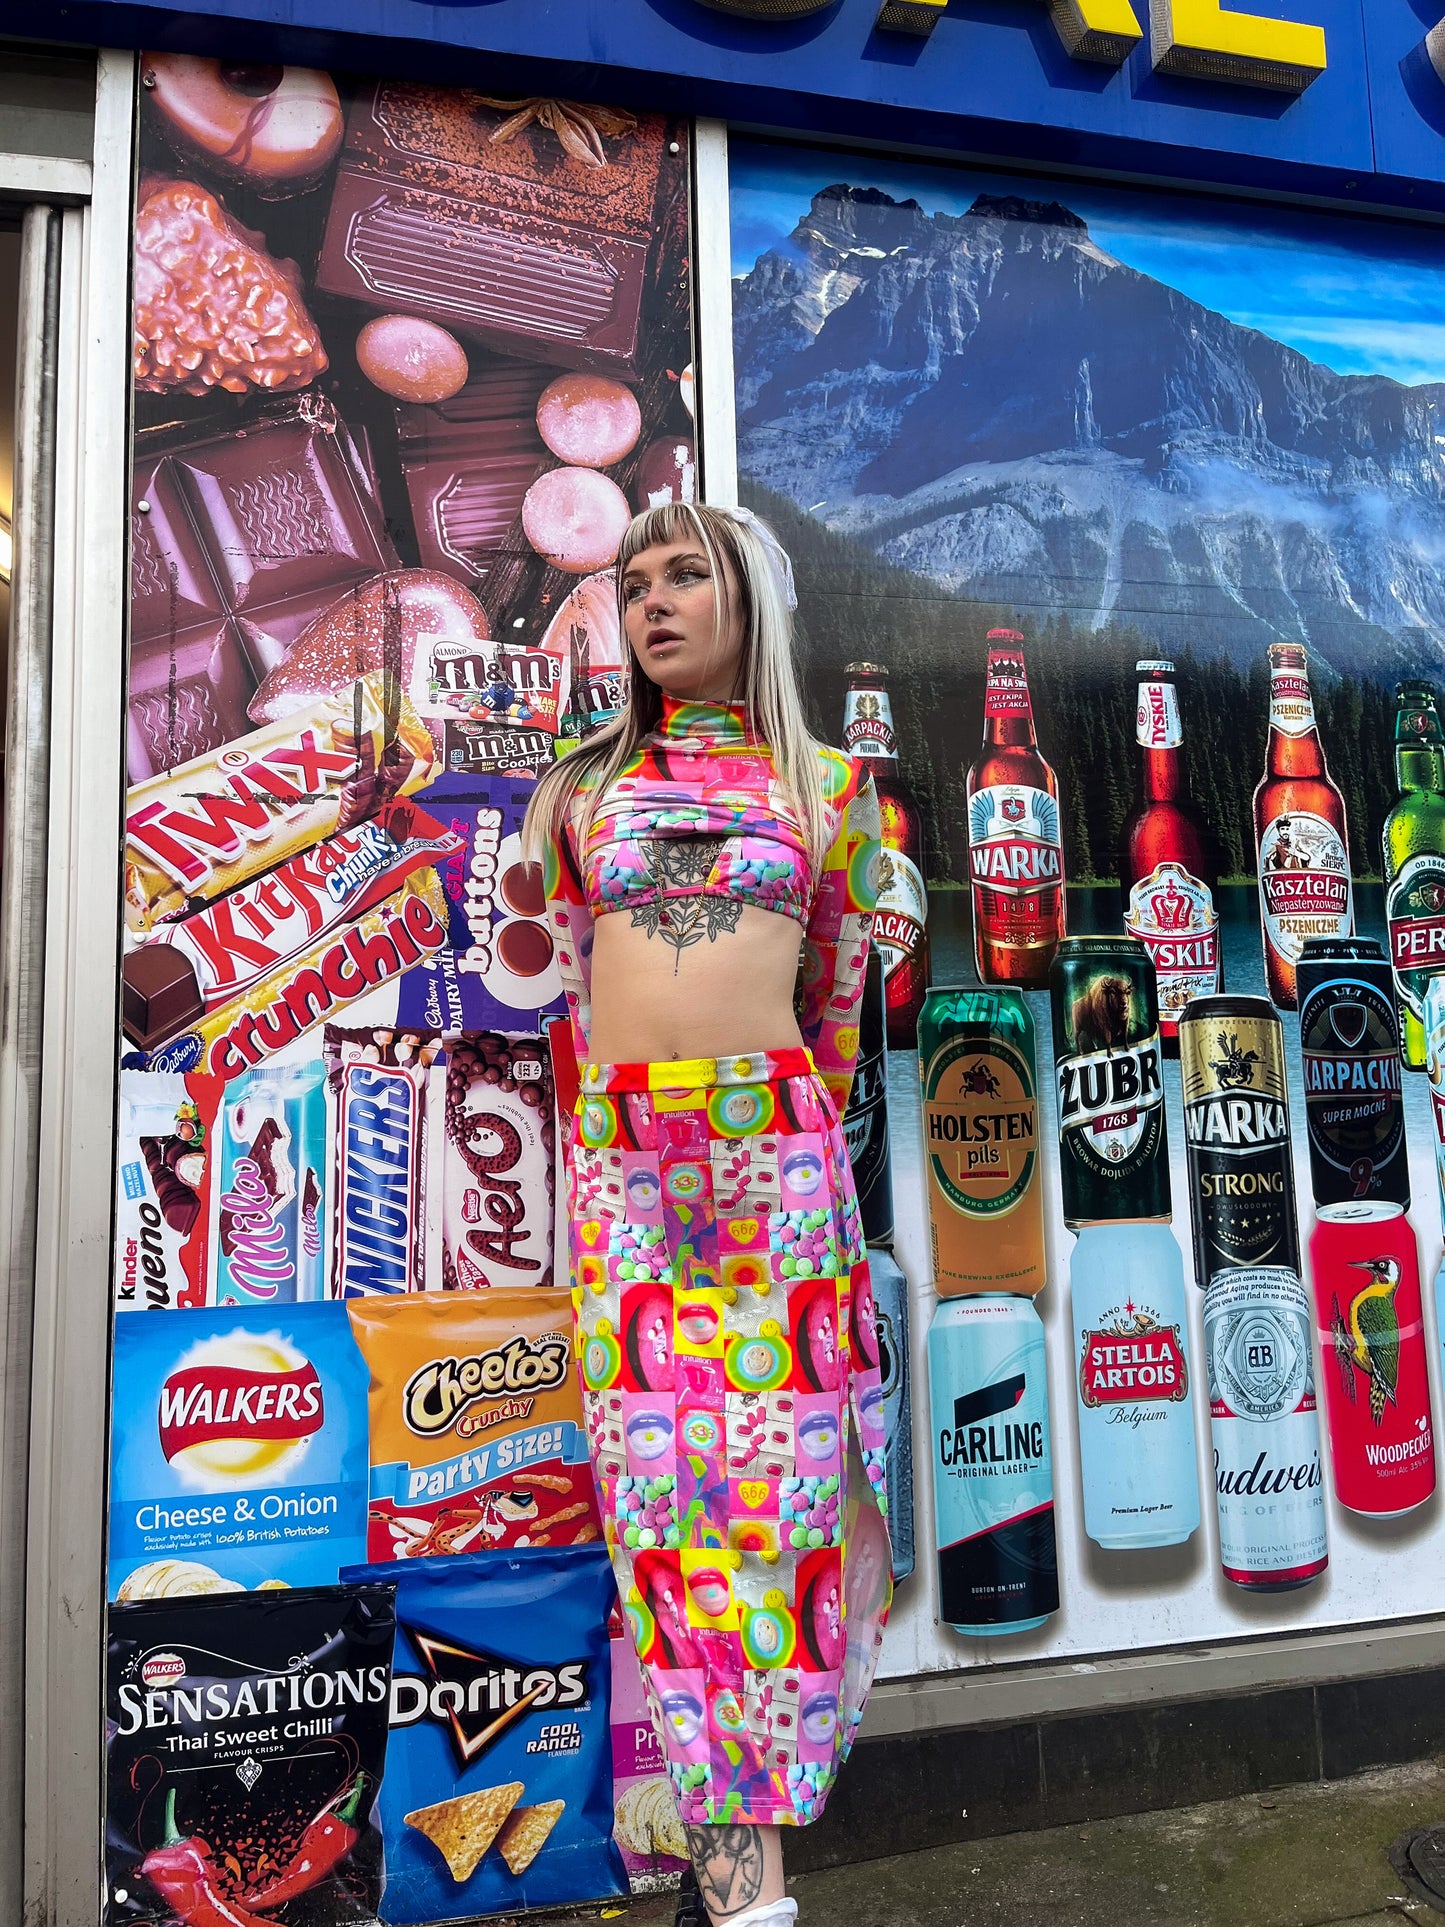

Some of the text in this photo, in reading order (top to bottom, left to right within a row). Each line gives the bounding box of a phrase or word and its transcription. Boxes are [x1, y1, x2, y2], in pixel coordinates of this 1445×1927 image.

[435, 648, 467, 656] ALMOND
[1147, 685, 1166, 745] TYSKIE
[845, 721, 893, 742] KARPACKIE
[497, 754, 553, 769] Cookies
[357, 858, 391, 882] have
[393, 852, 402, 862] a
[972, 845, 1060, 880] WARKA
[1415, 861, 1426, 869] OD
[456, 806, 504, 976] buttons
[1263, 875, 1347, 901] Kasztelan
[1271, 898, 1344, 913] Niepasteryzowane
[873, 914, 920, 948] ACKIE
[1279, 919, 1339, 934] PSZENICZNE
[1143, 938, 1214, 967] YSKIE
[1397, 927, 1445, 958] PER
[209, 895, 446, 1080] crunchie
[444, 949, 464, 1032] DAIRY MIL
[424, 979, 443, 1029] Cadbury
[155, 1041, 196, 1073] Cadbury
[663, 1111, 695, 1119] Intuition
[1103, 1114, 1128, 1129] 1768
[1185, 1100, 1287, 1144] WARKA
[1323, 1099, 1386, 1123] SUPER MOCNE
[929, 1112, 1033, 1143] HOLSTEN
[968, 1145, 1000, 1169] pils
[1073, 1138, 1099, 1172] BROWAR
[1101, 1166, 1135, 1180] DOJLIDY
[124, 1167, 136, 1196] MILK AND
[131, 1163, 142, 1197] HAZELNUTS
[345, 1068, 410, 1298] NICKERS
[466, 1112, 541, 1271] Aero
[670, 1177, 700, 1189] 333
[1200, 1171, 1284, 1198] STRONG
[945, 1182, 983, 1208] HAMBURG
[731, 1223, 757, 1237] 666
[138, 1202, 170, 1310] ueno
[117, 1237, 138, 1300] kinder
[942, 1269, 956, 1278] PURE
[995, 1265, 1036, 1280] EXCELLENCE
[1230, 1285, 1249, 1293] Aging
[1251, 1282, 1280, 1290] produces
[1233, 1292, 1246, 1301] will
[1247, 1291, 1260, 1301] find
[1098, 1305, 1160, 1324] ANNO 1366
[533, 1335, 571, 1347] REAL CHEESE!
[1092, 1343, 1174, 1365] STELLA
[408, 1338, 564, 1431] Cheetos
[1092, 1365, 1175, 1389] ARTOIS
[161, 1382, 322, 1428] WALKERS
[458, 1398, 534, 1436] Crunchy
[1250, 1403, 1280, 1412] AMERICA
[1105, 1406, 1168, 1429] Belgium
[687, 1426, 715, 1439] 333
[940, 1422, 1043, 1466] CARLING
[408, 1426, 563, 1499] Party Size!
[957, 1464, 1028, 1478] ORIGINAL LAGER
[1376, 1468, 1396, 1478] 500ml
[741, 1487, 767, 1499] 666
[136, 1492, 338, 1531] Cheese & Onion
[1255, 1505, 1277, 1516] OF
[144, 1535, 167, 1543] Flavour
[216, 1525, 330, 1544] 100% British Potatoes
[1244, 1545, 1289, 1553] ORIGINAL
[1247, 1557, 1269, 1565] RICE
[1272, 1556, 1293, 1564] AND
[143, 1662, 184, 1676] WALKERS
[118, 1666, 387, 1735] SENSATIONS
[388, 1664, 585, 1724] Doritos
[166, 1718, 333, 1753] Thai Sweet Chilli
[540, 1722, 580, 1738] COOL
[214, 1744, 285, 1759] FLAVOUR CRISPS
[526, 1736, 582, 1753] RANCH
[547, 1748, 579, 1758] FLAVORED
